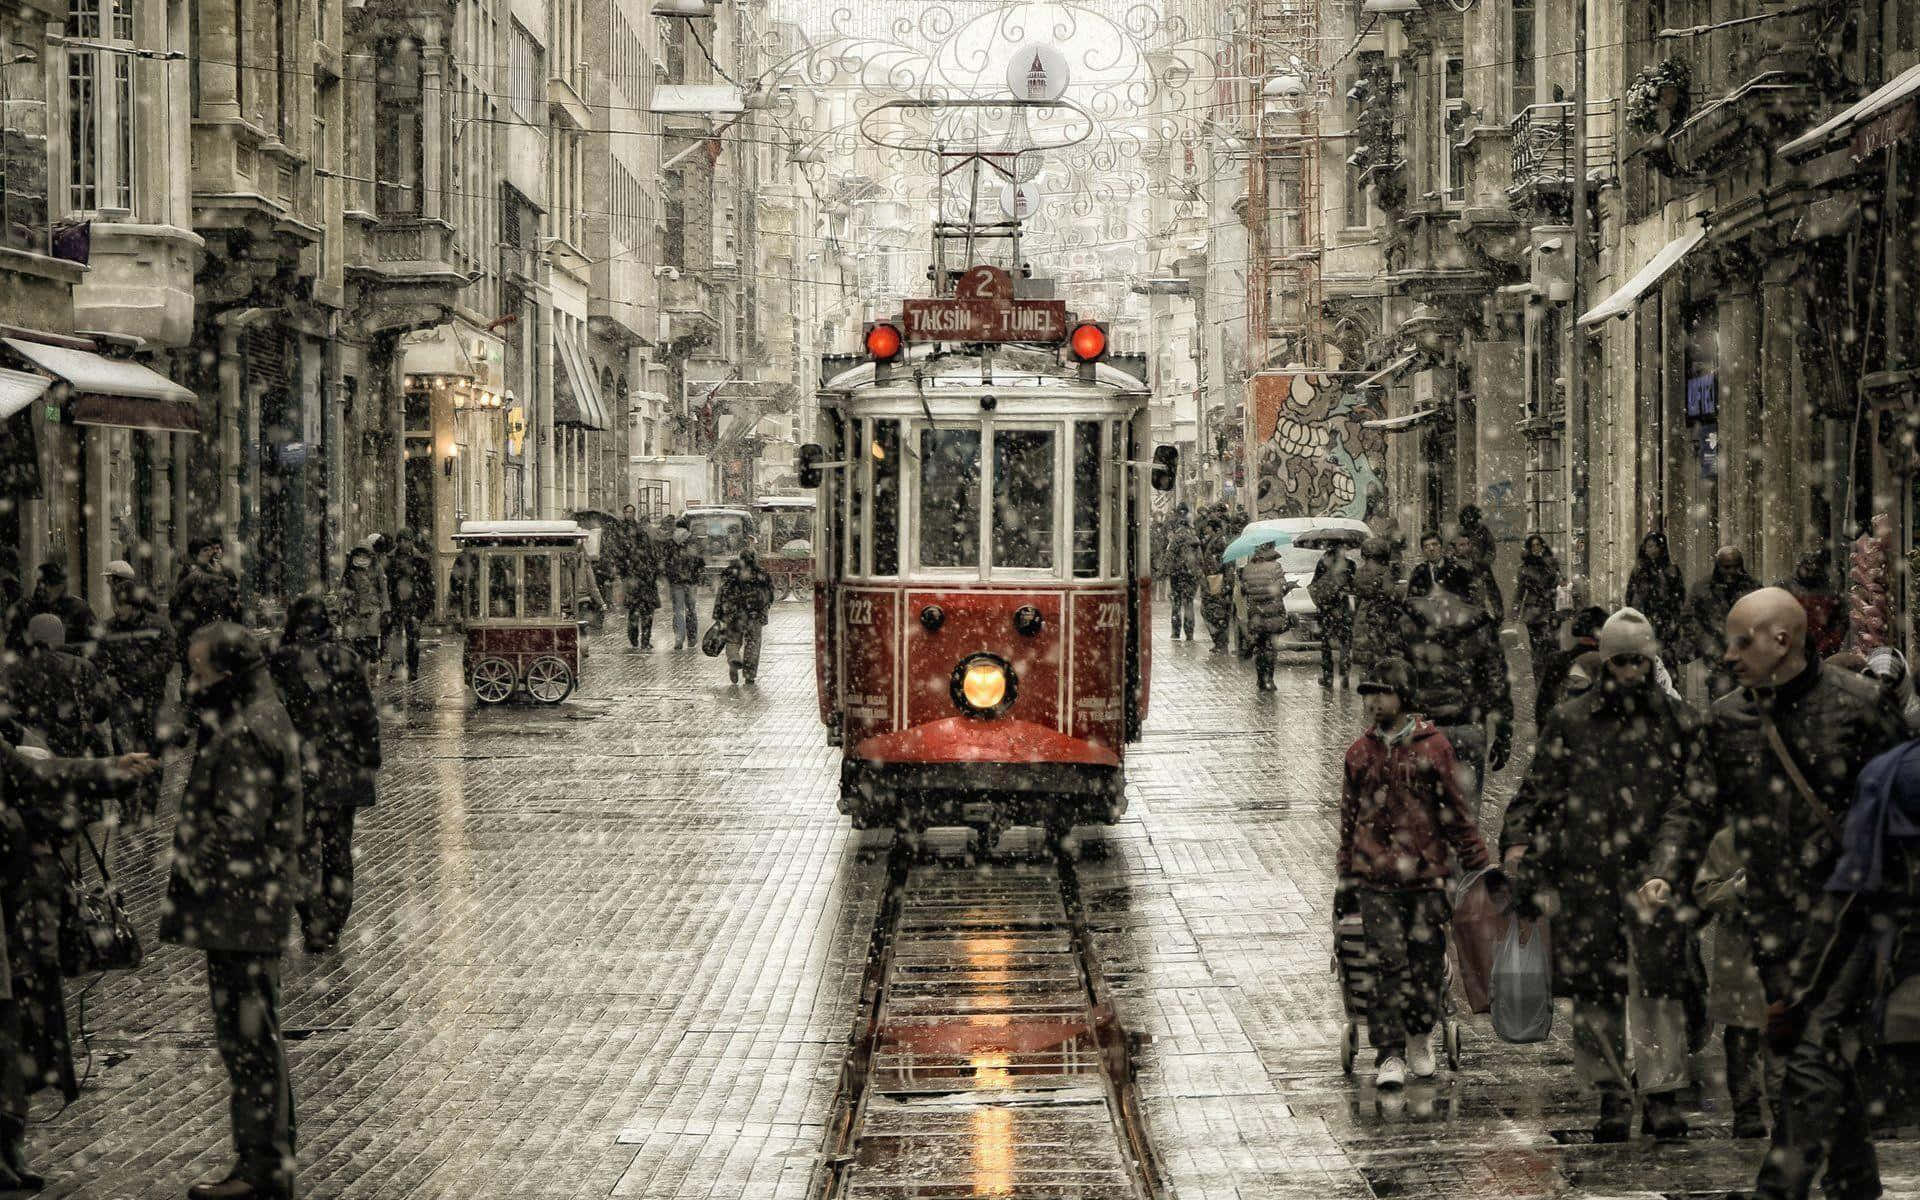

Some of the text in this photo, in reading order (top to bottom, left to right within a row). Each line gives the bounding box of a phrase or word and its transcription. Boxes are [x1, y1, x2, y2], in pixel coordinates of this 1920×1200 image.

[976, 271, 994, 298] 2
[1000, 306, 1057, 331] TÜNEL
[848, 599, 873, 624] 223
